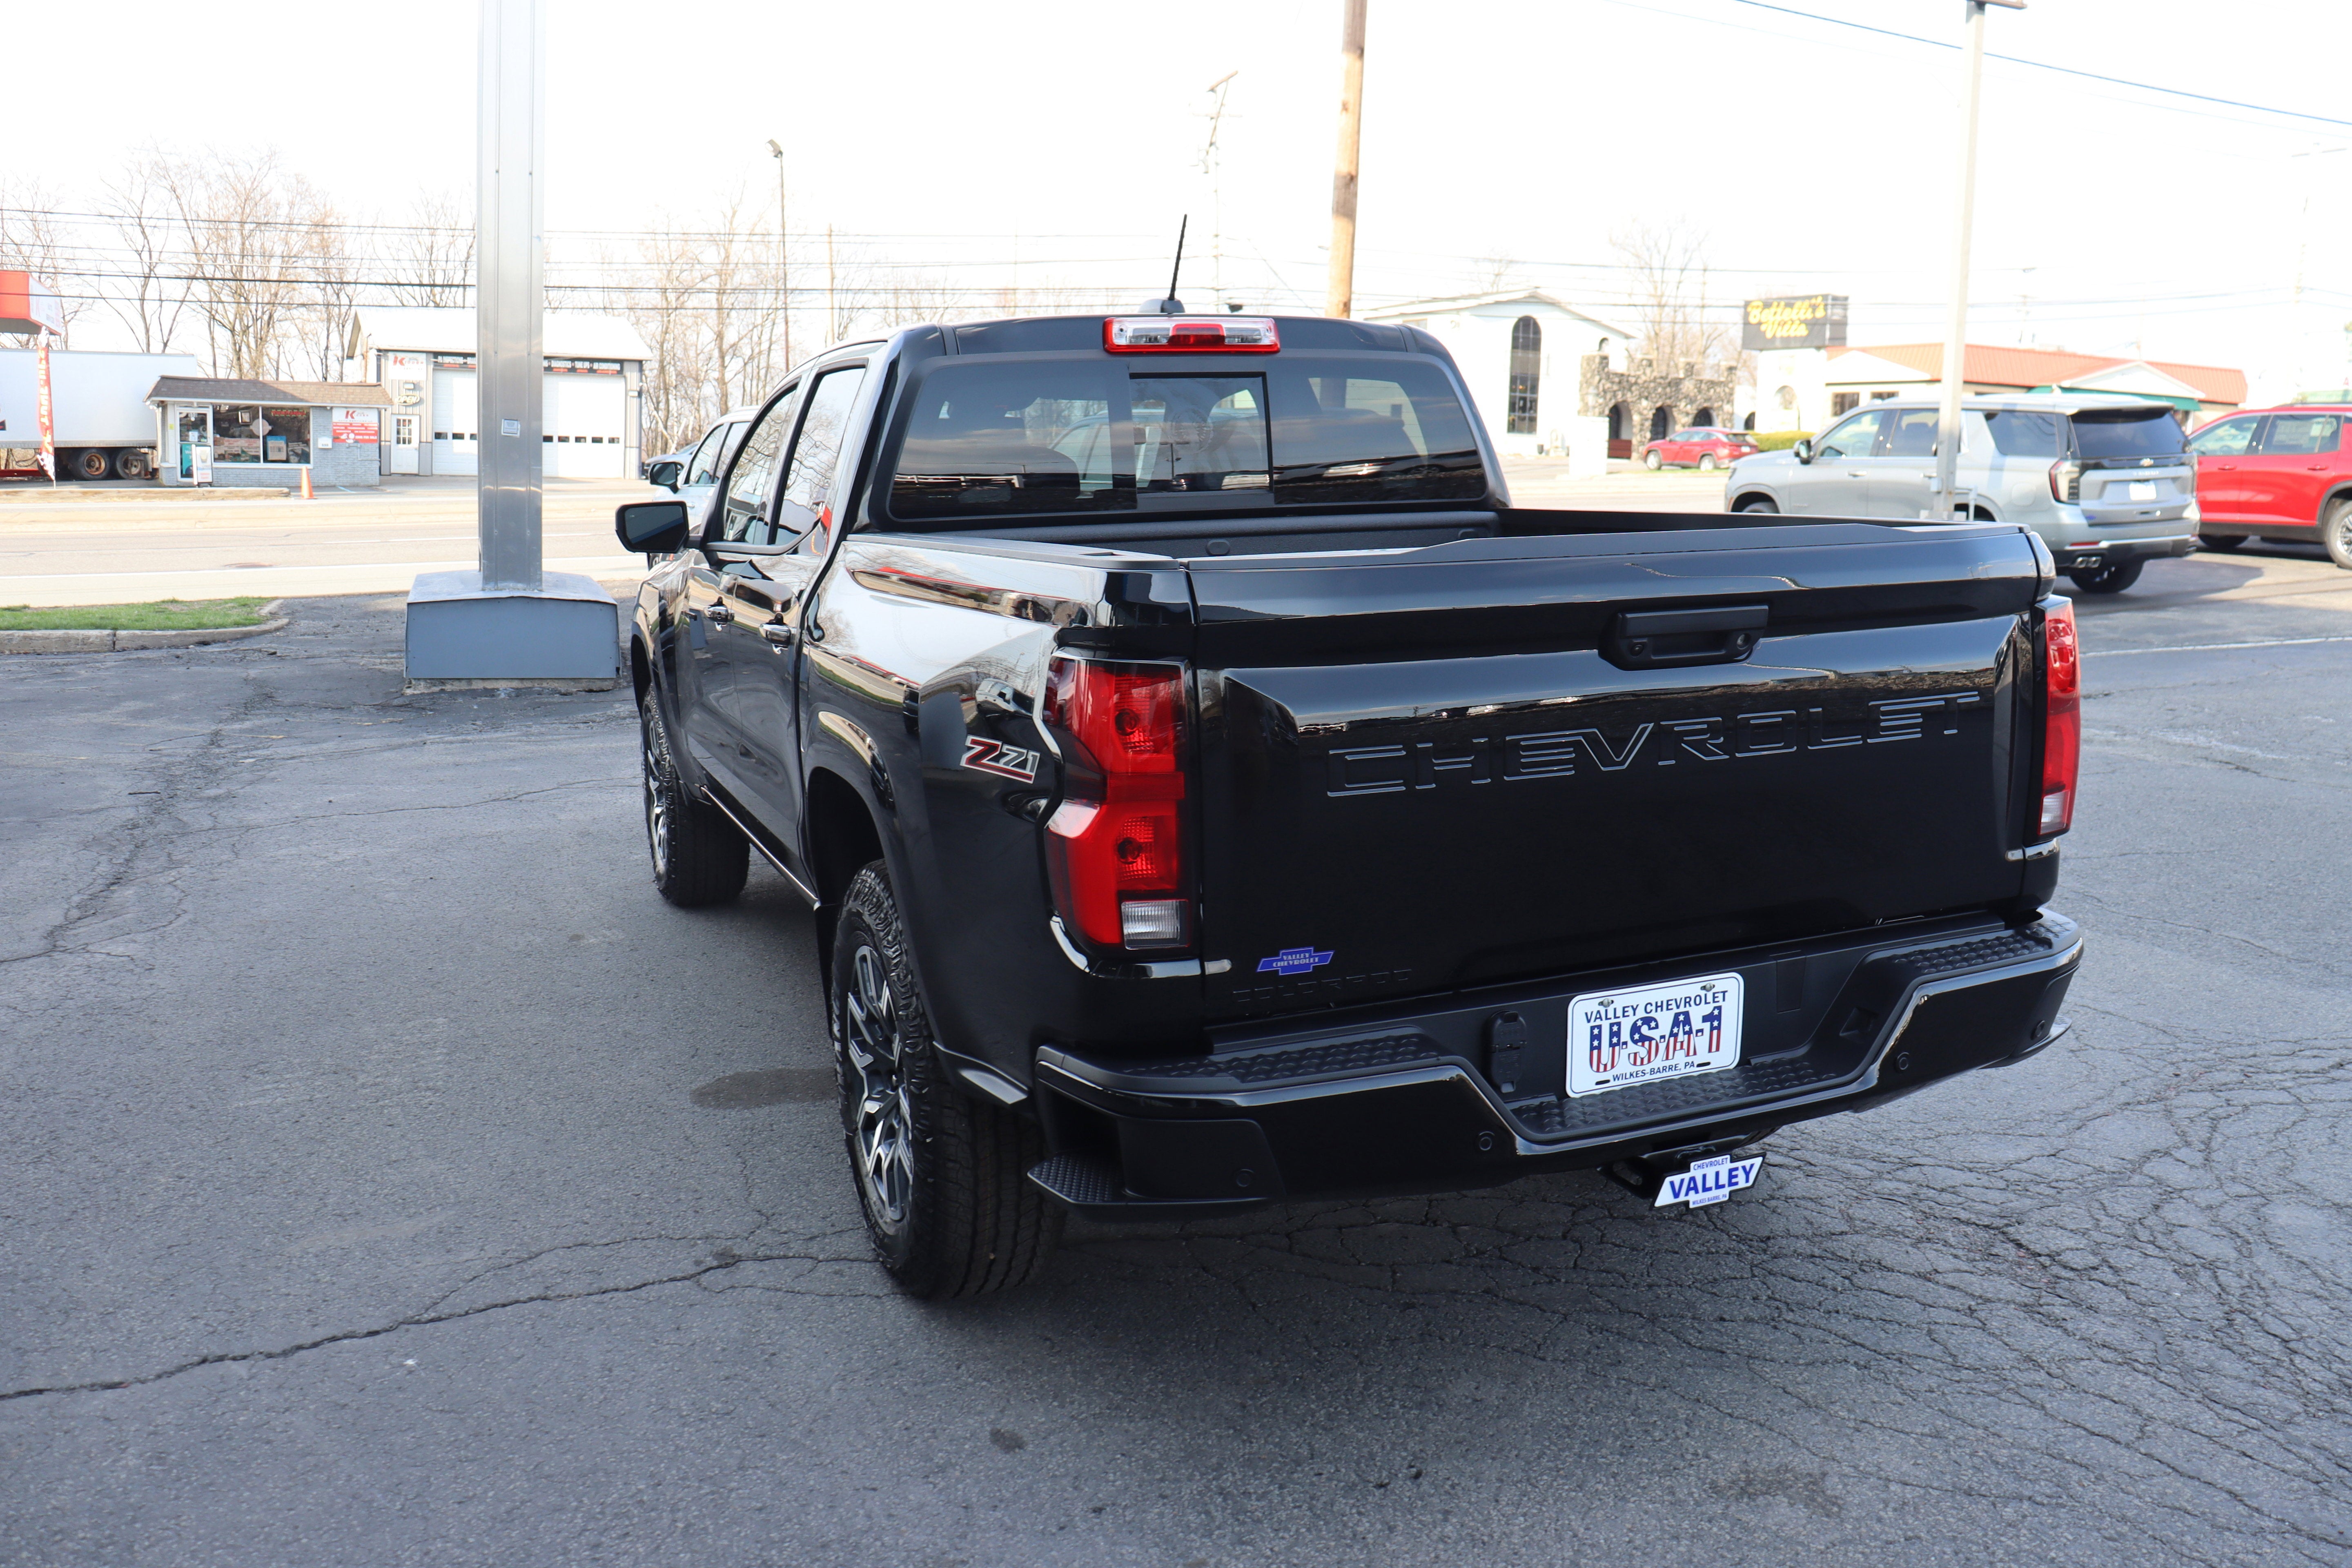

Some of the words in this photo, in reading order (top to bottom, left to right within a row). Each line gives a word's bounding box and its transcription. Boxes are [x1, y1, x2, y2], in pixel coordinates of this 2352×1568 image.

[1760, 319, 1809, 339] Villa
[1327, 691, 1980, 797] CHEVROLET
[960, 734, 1040, 784] Z71
[1273, 957, 1319, 967] CHEVROLET
[1585, 1004, 1639, 1024] VALLEY
[1644, 990, 1728, 1014] CHEVROLET
[1613, 1063, 1682, 1082] WILKES-BARRE,
[1684, 1061, 1695, 1069] PA
[1693, 1157, 1728, 1171] CHEVROLET
[1669, 1163, 1755, 1200] VALLEY
[1692, 1197, 1707, 1206] WILKES
